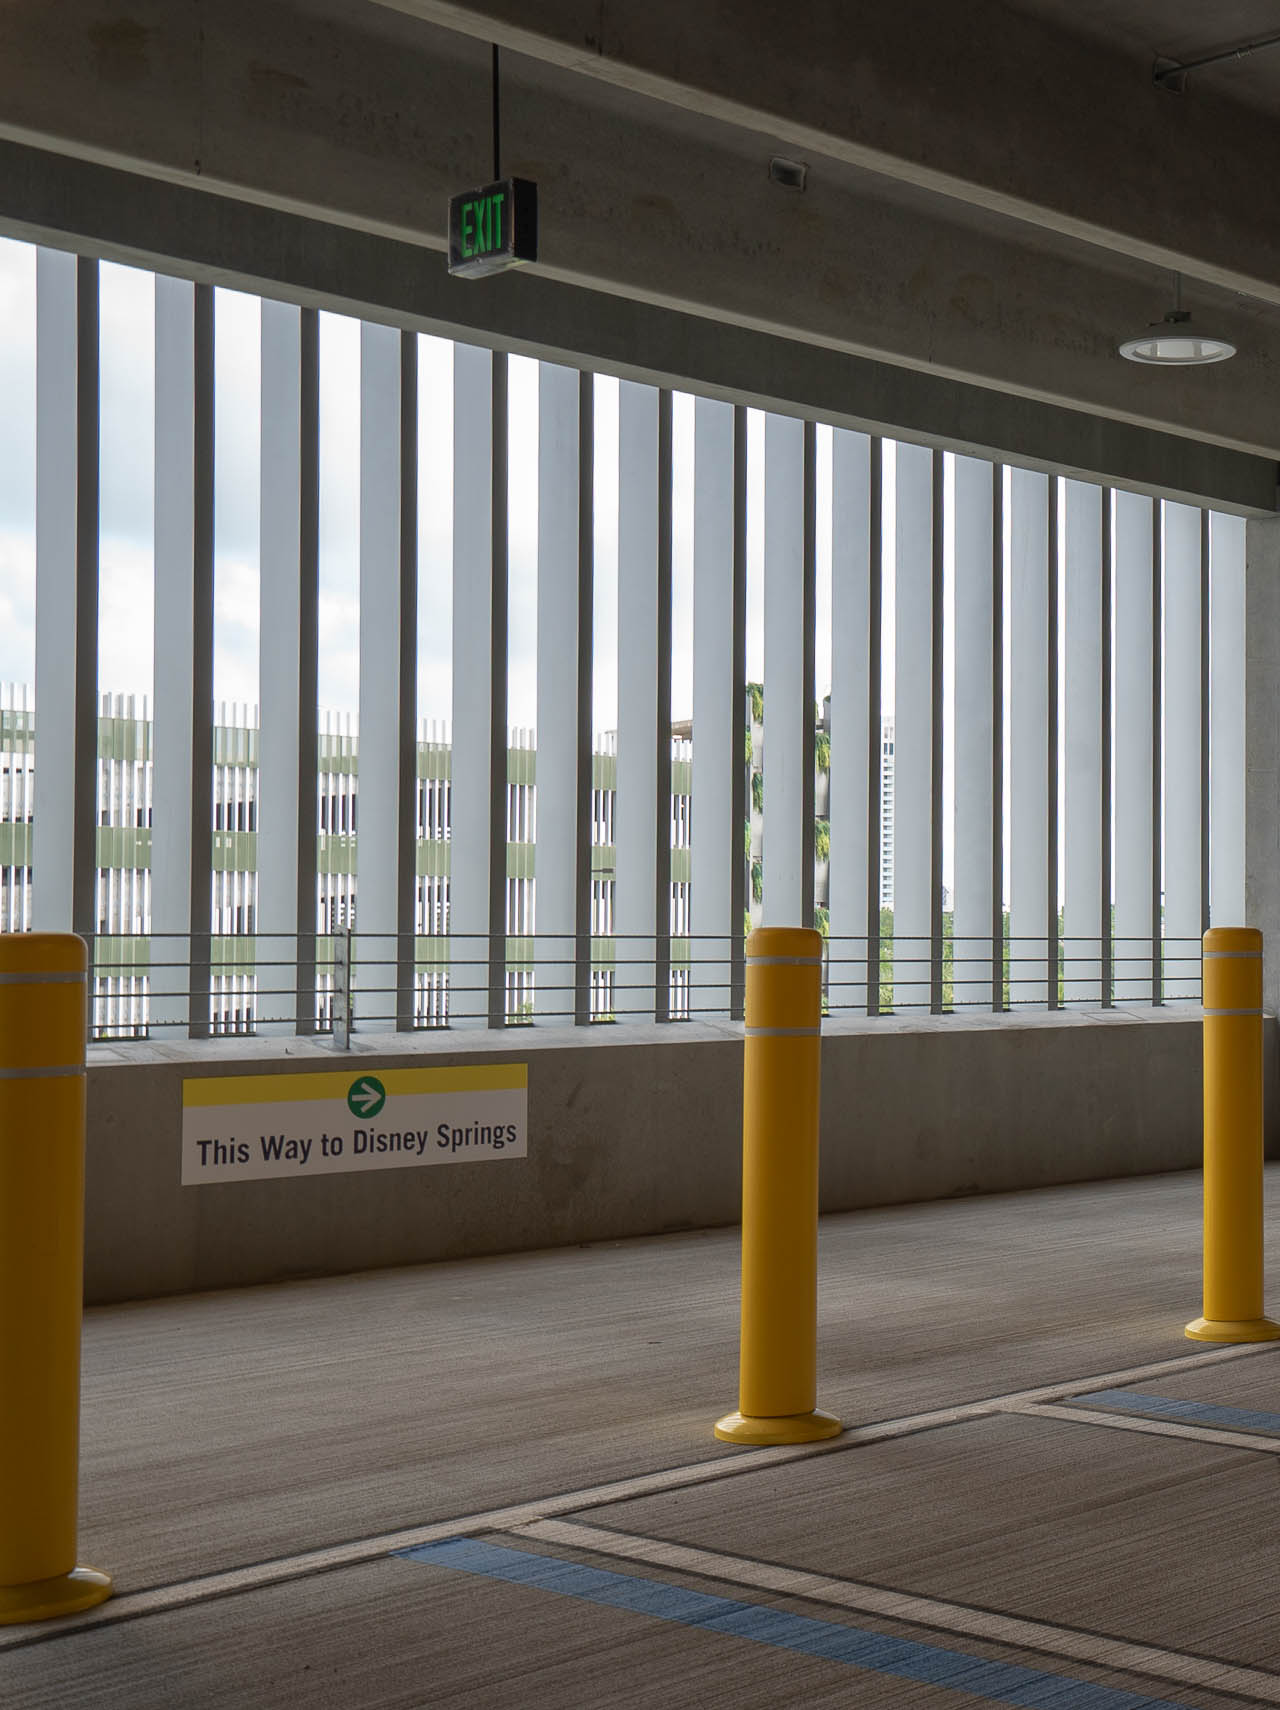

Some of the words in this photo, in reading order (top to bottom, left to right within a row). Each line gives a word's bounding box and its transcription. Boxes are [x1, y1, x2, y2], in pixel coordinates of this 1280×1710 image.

[462, 192, 505, 259] EXIT
[196, 1137, 250, 1166] This
[260, 1134, 312, 1164] Way
[320, 1133, 343, 1157] to
[353, 1127, 428, 1155] Disney
[436, 1121, 518, 1152] Springs
